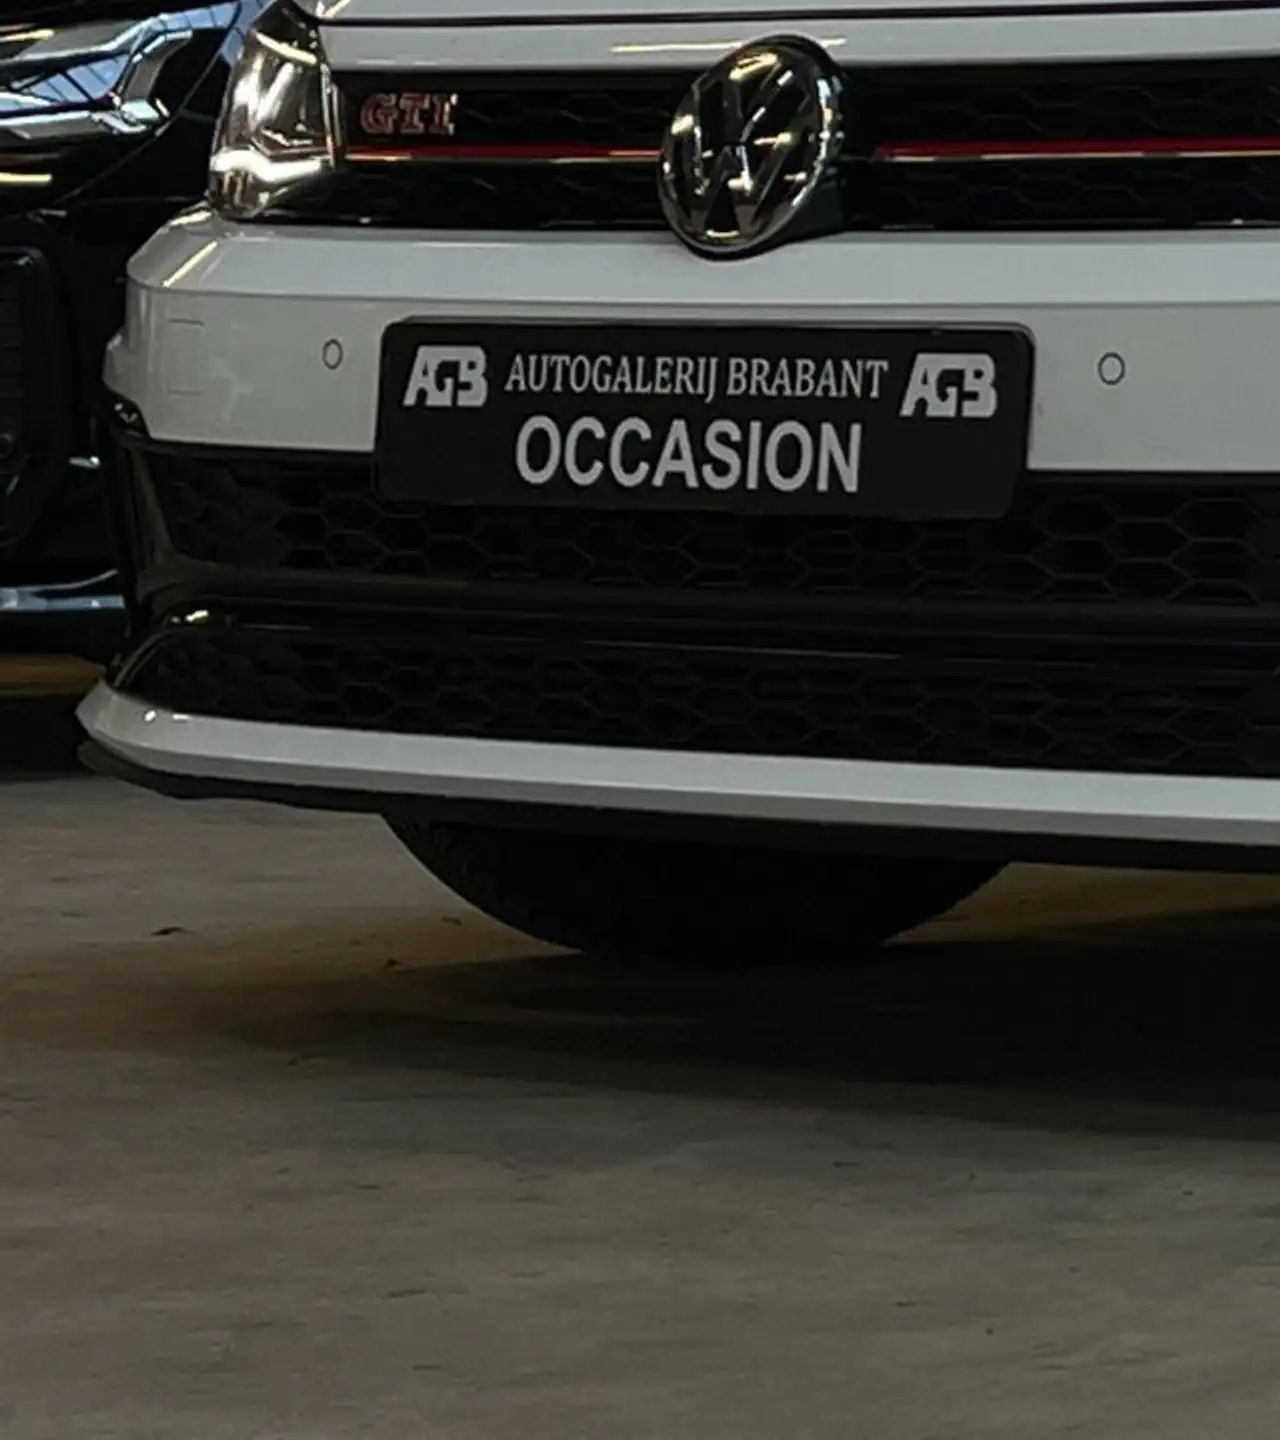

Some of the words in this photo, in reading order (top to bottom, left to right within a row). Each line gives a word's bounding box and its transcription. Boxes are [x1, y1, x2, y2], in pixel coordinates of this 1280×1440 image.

[360, 91, 459, 137] GTI
[403, 345, 490, 407] AGB
[503, 353, 717, 404] AUTOGALERIJ
[725, 356, 890, 399] BRABANT
[900, 351, 999, 418] AGB
[514, 415, 863, 494] OCCASION
